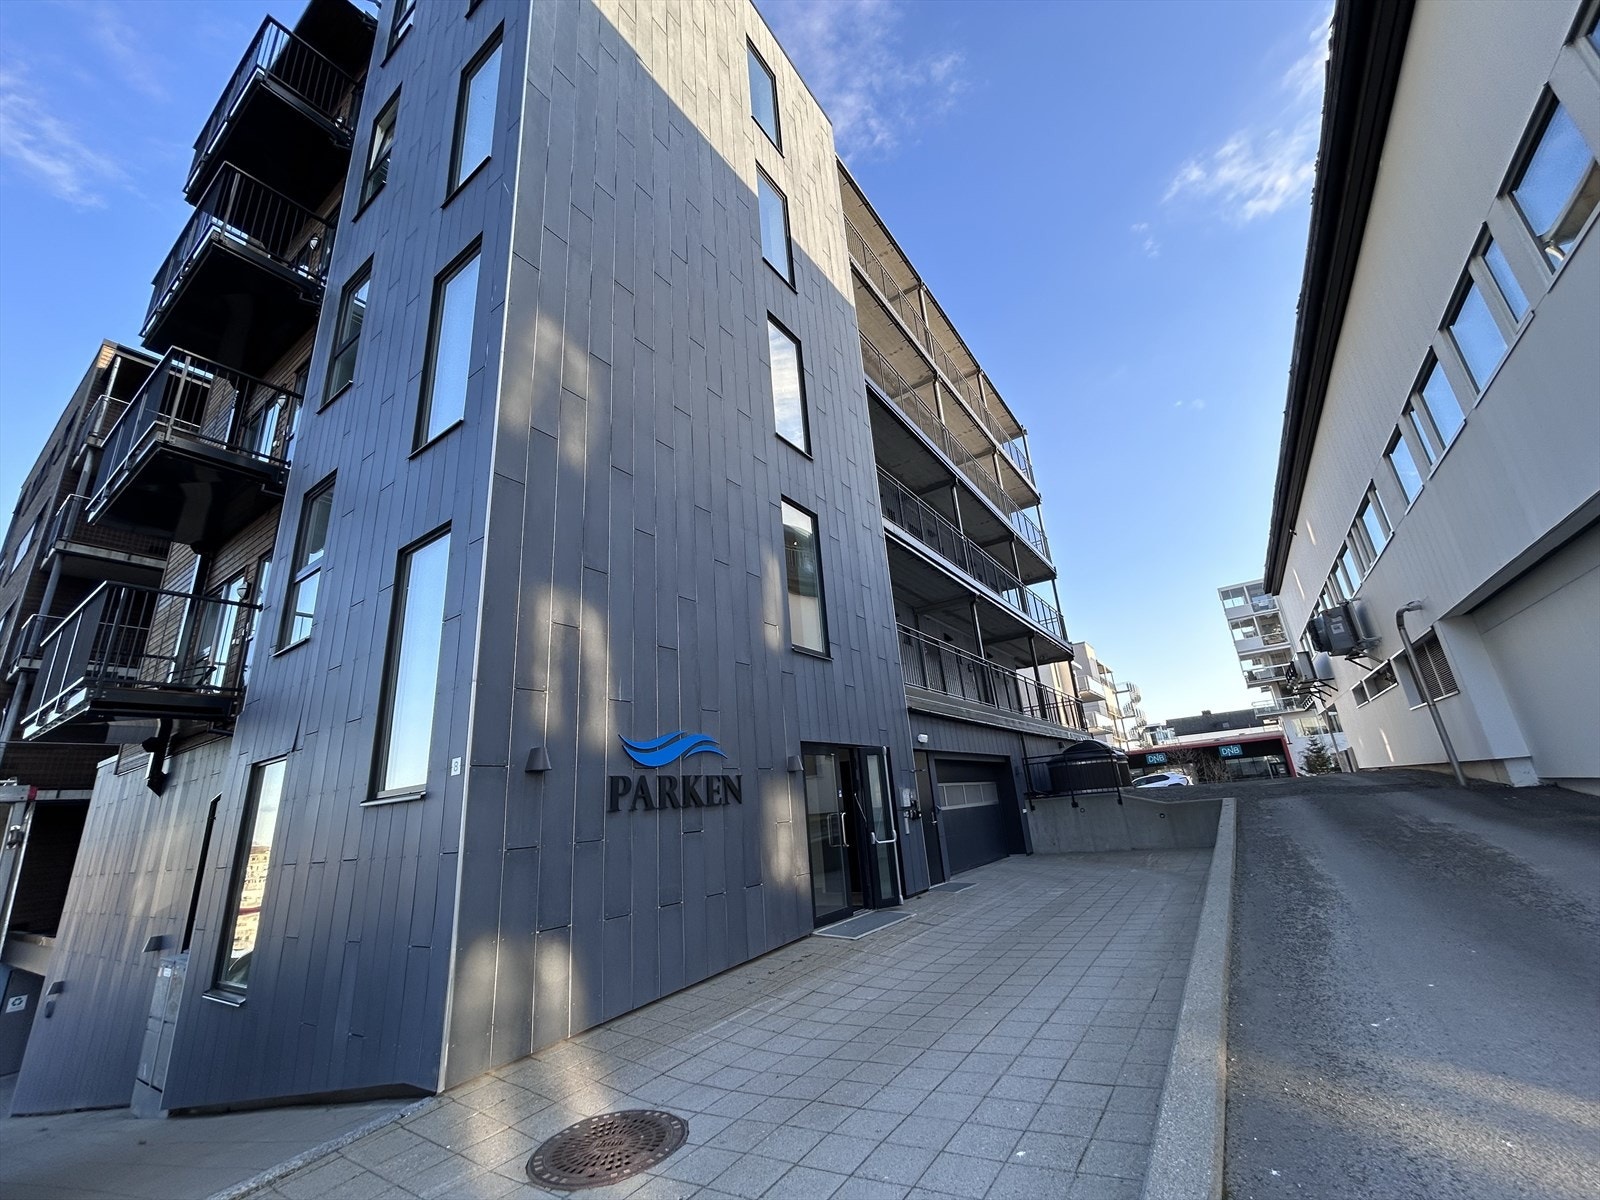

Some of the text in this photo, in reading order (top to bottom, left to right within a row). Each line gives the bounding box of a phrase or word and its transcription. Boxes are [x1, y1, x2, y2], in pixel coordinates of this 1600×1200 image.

[1221, 744, 1240, 756] DNB
[1147, 753, 1165, 764] DNB
[606, 774, 743, 813] PARKEN
